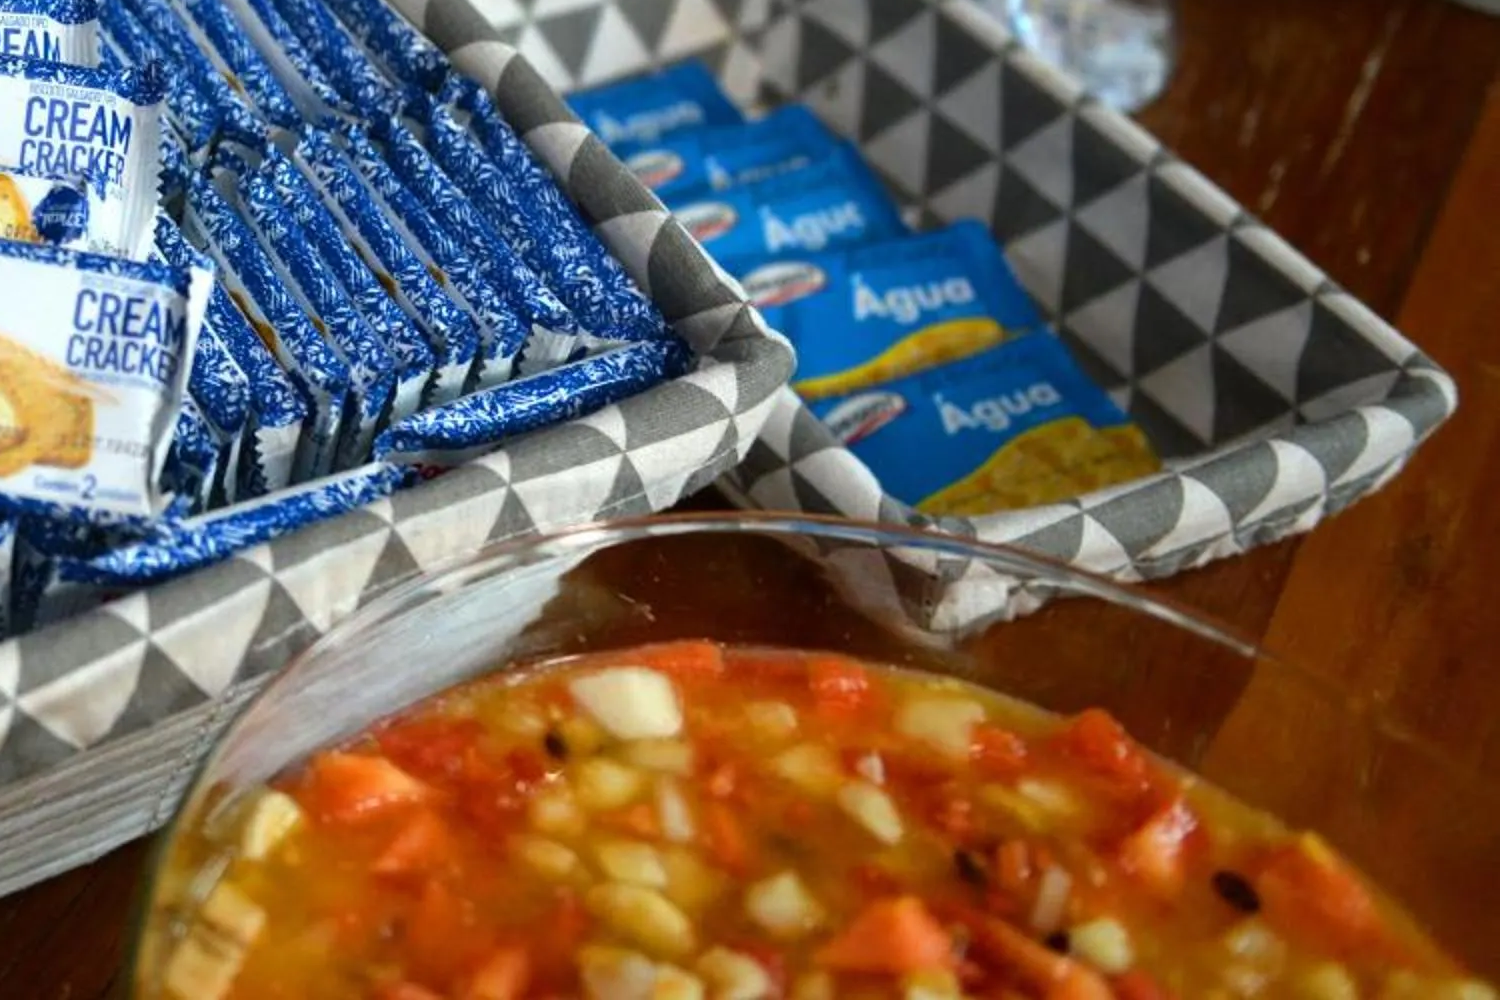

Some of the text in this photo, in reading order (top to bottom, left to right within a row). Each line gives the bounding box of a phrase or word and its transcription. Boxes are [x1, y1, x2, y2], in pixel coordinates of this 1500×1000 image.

[24, 95, 133, 155] CREAM
[19, 139, 125, 187] CRACKER
[73, 288, 188, 358] CREAM
[853, 272, 975, 324] Água
[933, 384, 1062, 435] Água
[81, 473, 97, 499] 2
